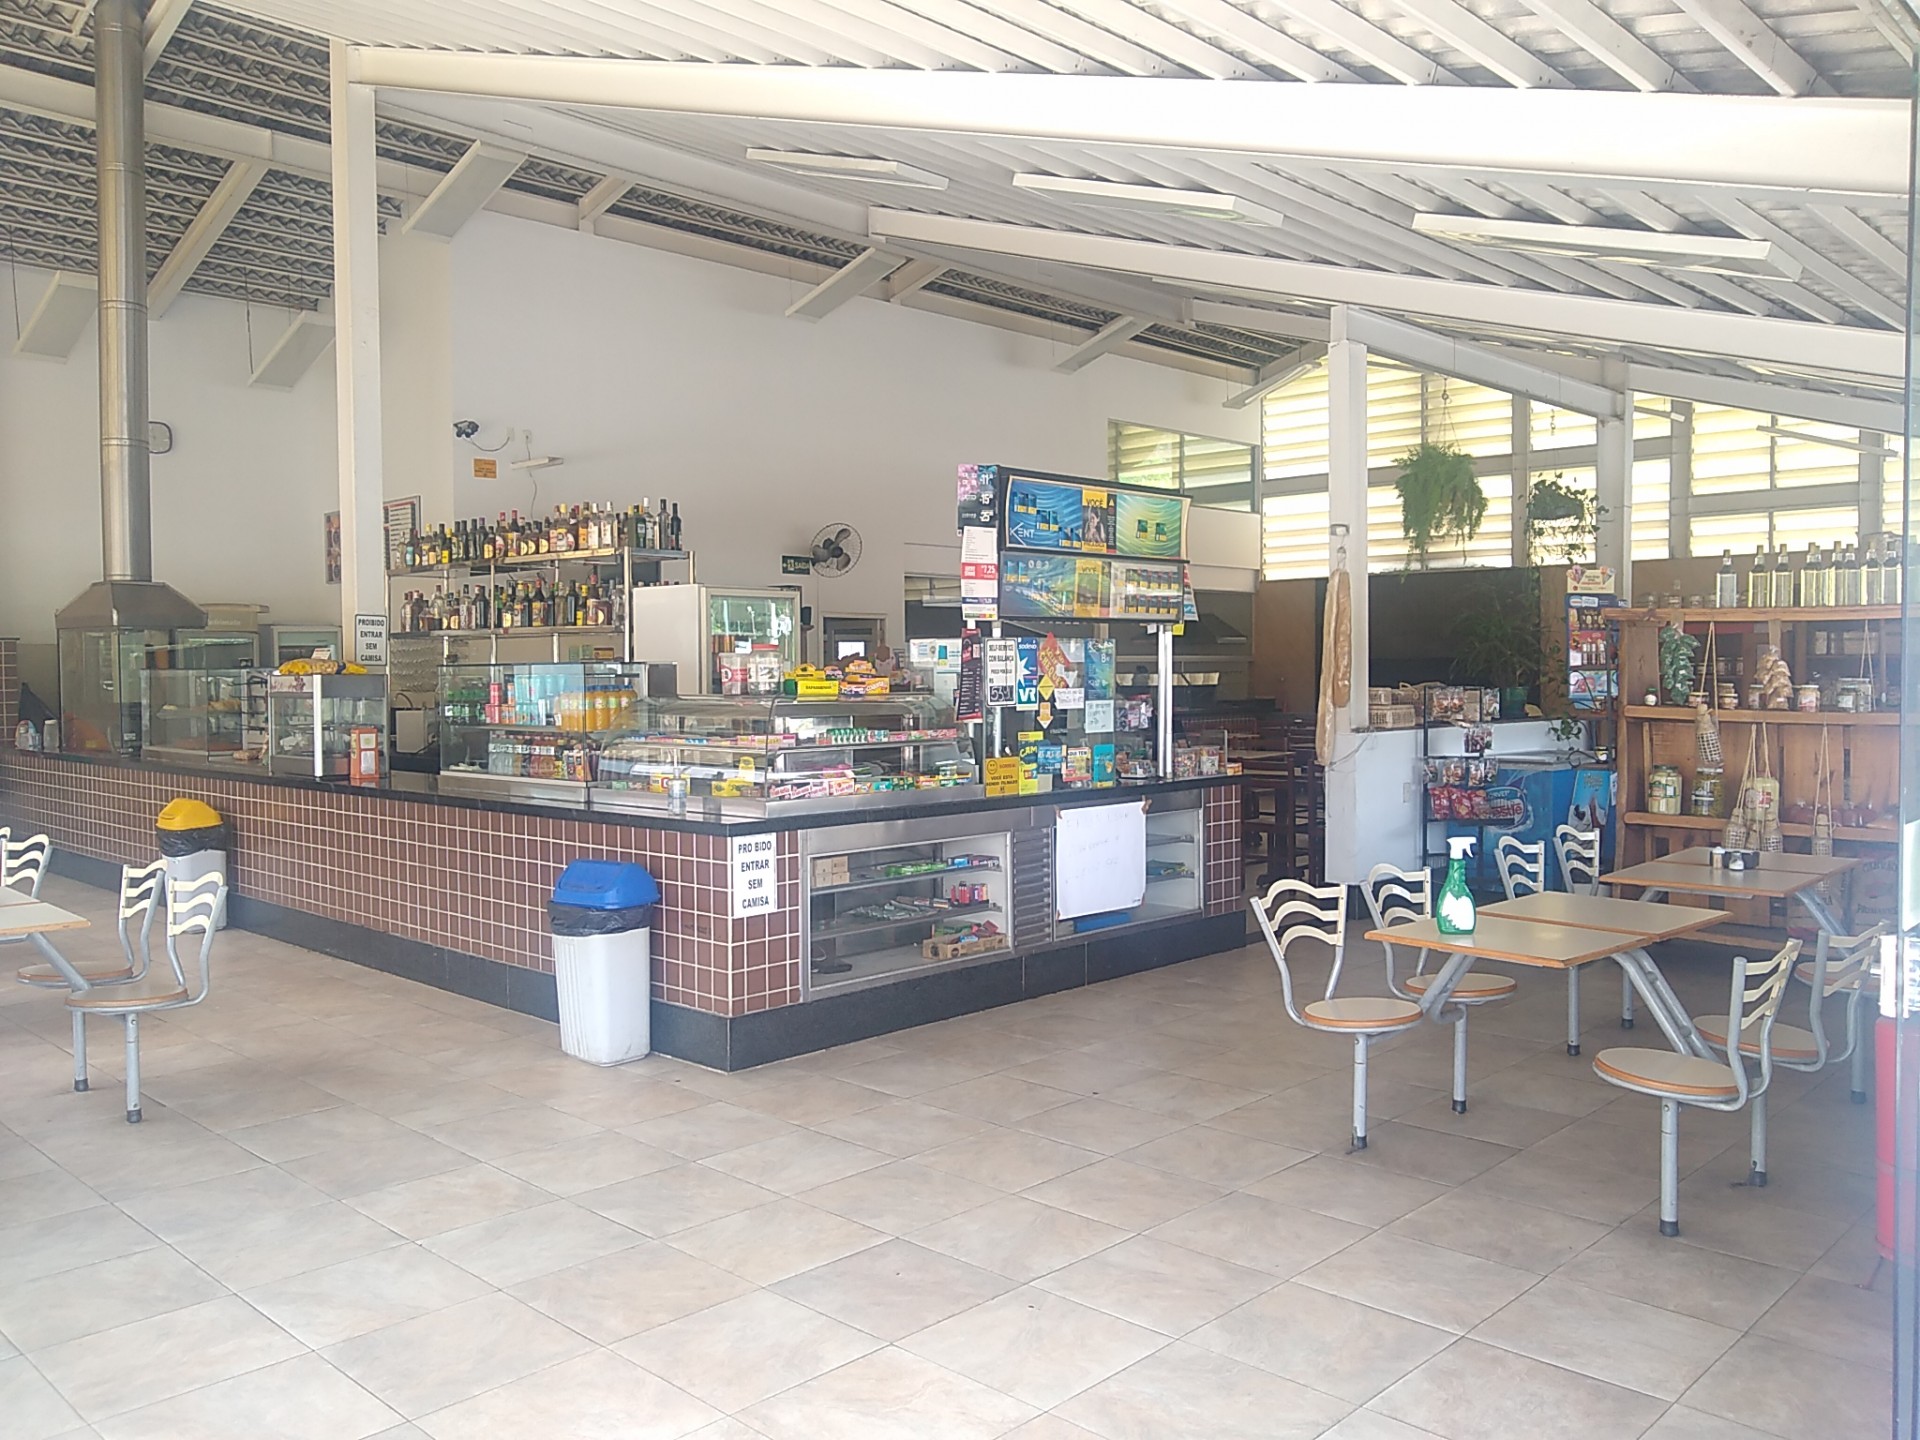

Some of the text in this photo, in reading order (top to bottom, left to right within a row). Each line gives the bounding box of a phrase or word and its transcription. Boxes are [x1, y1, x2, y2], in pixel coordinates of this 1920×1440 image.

[1010, 522, 1035, 546] KENT
[358, 618, 385, 627] PROIBIDO
[365, 642, 378, 650] SEM
[360, 654, 382, 662] CAMISA
[1018, 688, 1036, 701] VR
[738, 841, 772, 854] PROBIDO
[741, 859, 770, 872] ENTRAR
[748, 878, 763, 890] SEM
[742, 896, 769, 909] CAMISA
